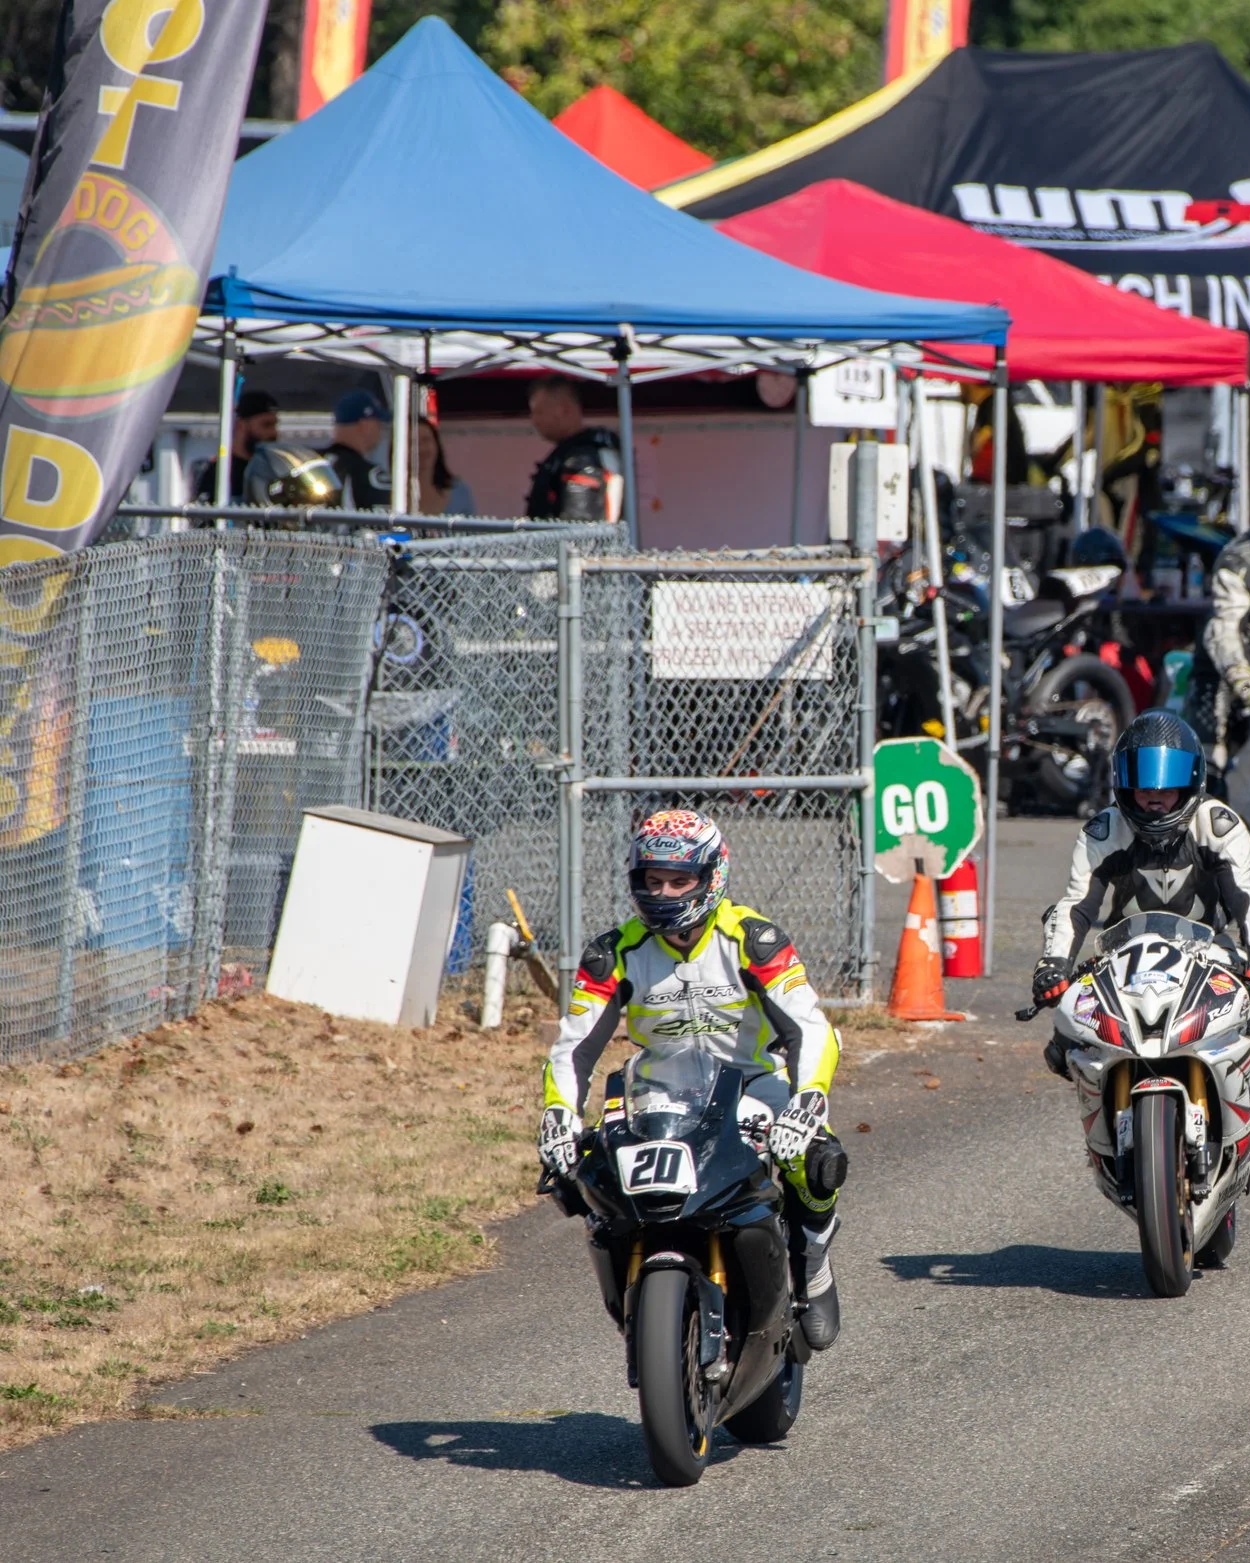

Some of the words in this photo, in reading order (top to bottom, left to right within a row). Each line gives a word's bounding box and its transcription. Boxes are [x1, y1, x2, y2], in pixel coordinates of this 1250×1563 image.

[73, 180, 157, 252] DOG
[707, 594, 736, 613] ARE
[881, 780, 949, 837] GO
[649, 837, 678, 849] Arai
[1208, 1001, 1233, 1021] R6
[629, 1147, 683, 1188] 20
